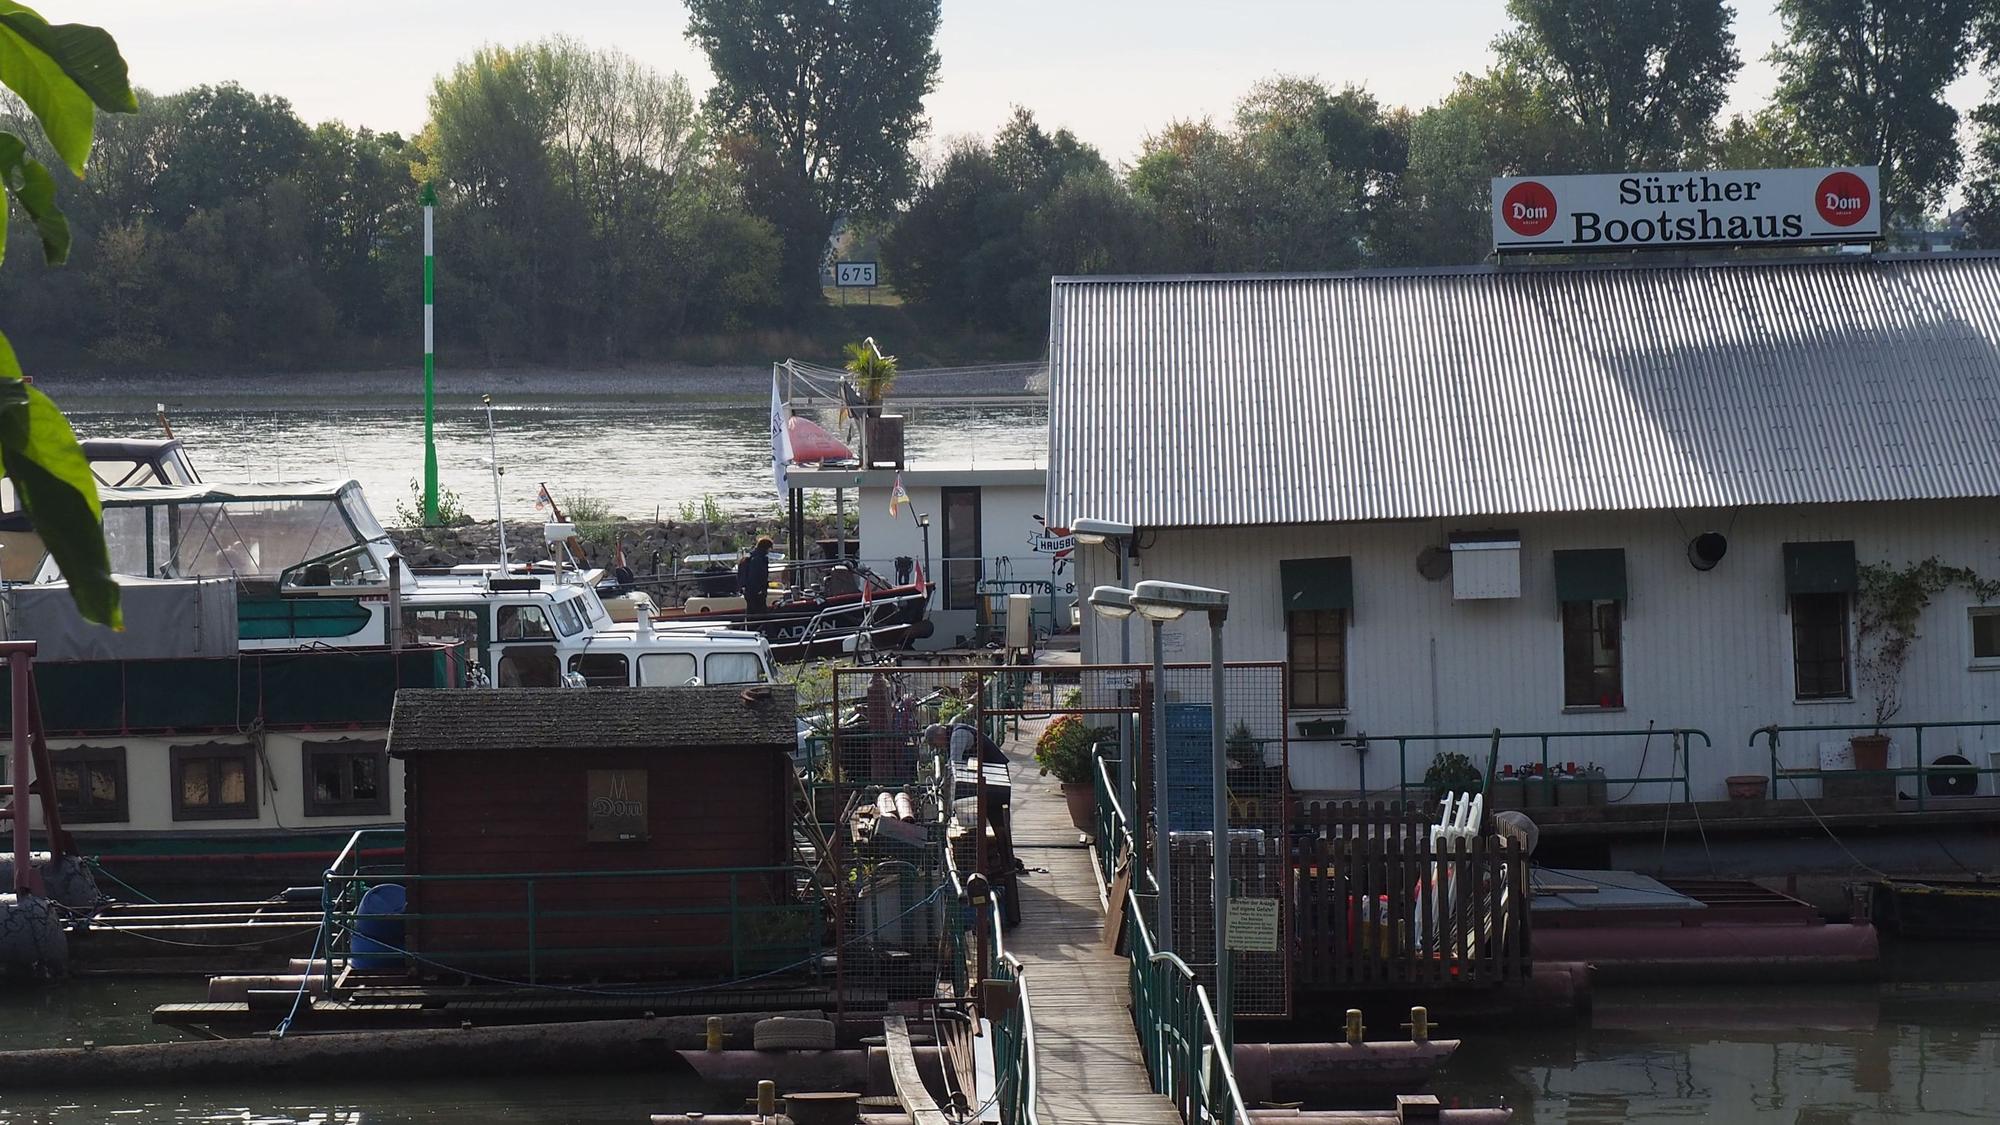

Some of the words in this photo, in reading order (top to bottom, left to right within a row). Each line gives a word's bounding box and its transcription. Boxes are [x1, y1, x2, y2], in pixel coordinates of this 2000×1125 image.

[1619, 177, 1761, 205] Sürther
[1825, 192, 1861, 210] Dom
[1512, 202, 1547, 220] Dom
[1571, 209, 1803, 244] Bootshaus
[841, 267, 872, 281] 675
[1020, 582, 1052, 595] 0178
[592, 797, 642, 816] Dom
